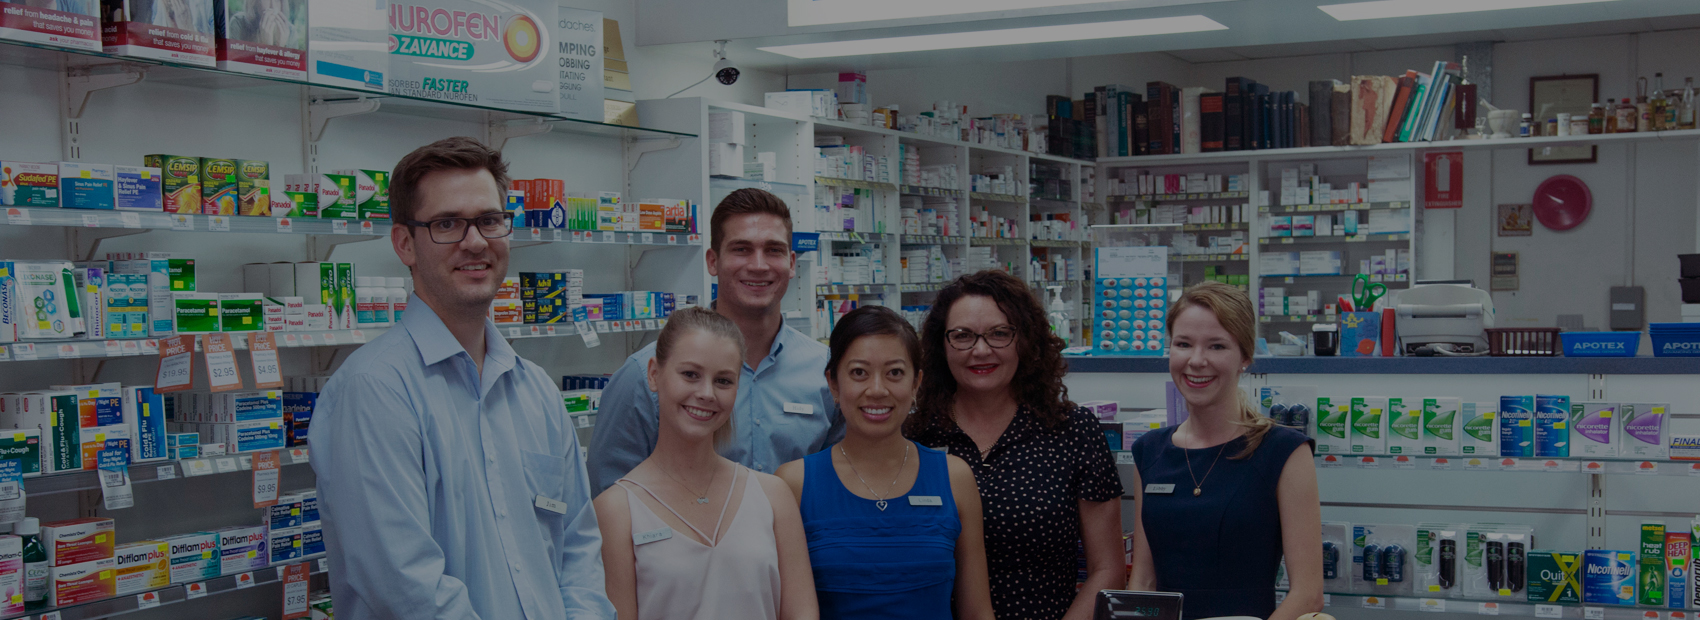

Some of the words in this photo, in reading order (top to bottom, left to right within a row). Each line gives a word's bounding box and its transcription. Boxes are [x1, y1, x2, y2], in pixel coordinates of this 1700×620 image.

[4, 7, 23, 16] relief
[24, 9, 38, 18] from
[40, 11, 72, 23] headache
[80, 18, 93, 27] pain
[33, 20, 44, 29] that
[46, 23, 62, 32] saves
[75, 28, 94, 37] money
[558, 19, 596, 32] daches.
[180, 32, 194, 40] cold
[192, 44, 209, 53] money
[257, 46, 278, 56] hayfever
[284, 51, 300, 60] allergy
[400, 38, 468, 58] ZAVANCE
[559, 42, 596, 56] MPING
[286, 60, 300, 68] money
[559, 57, 590, 70] OBBING
[390, 79, 420, 89] SORBED
[422, 77, 468, 92] FASTER
[403, 88, 442, 99] STANDARD
[444, 92, 478, 101] NUROFEN
[169, 162, 198, 172] LEMSIP
[208, 165, 234, 174] LEMSIP
[243, 165, 266, 173] LEMSIP
[19, 174, 46, 183] Sudafed
[272, 200, 291, 209] Panadol
[666, 203, 685, 216] artia
[537, 279, 552, 287] Advil
[539, 304, 552, 312] Advil
[166, 345, 186, 356] PRICE
[208, 344, 226, 352] PRICE
[254, 342, 271, 350] PRICE
[163, 368, 188, 378] $19.95
[213, 367, 234, 378] $2.95
[258, 364, 277, 374] $4.95
[110, 398, 120, 407] PE
[119, 440, 128, 448] PE
[258, 461, 274, 469] PRICE
[258, 484, 276, 494] $9.95
[222, 536, 248, 546] Difflam
[248, 532, 263, 544] plus
[172, 543, 200, 554] Difflam
[200, 540, 216, 552] plus
[1668, 542, 1688, 551] DEEP
[118, 554, 147, 564] Difflam
[148, 550, 164, 562] plus
[1668, 548, 1687, 557] HEAT
[121, 572, 144, 580] ANAESTHETIC
[288, 573, 304, 582] PRICE
[287, 594, 306, 606] $7.95
